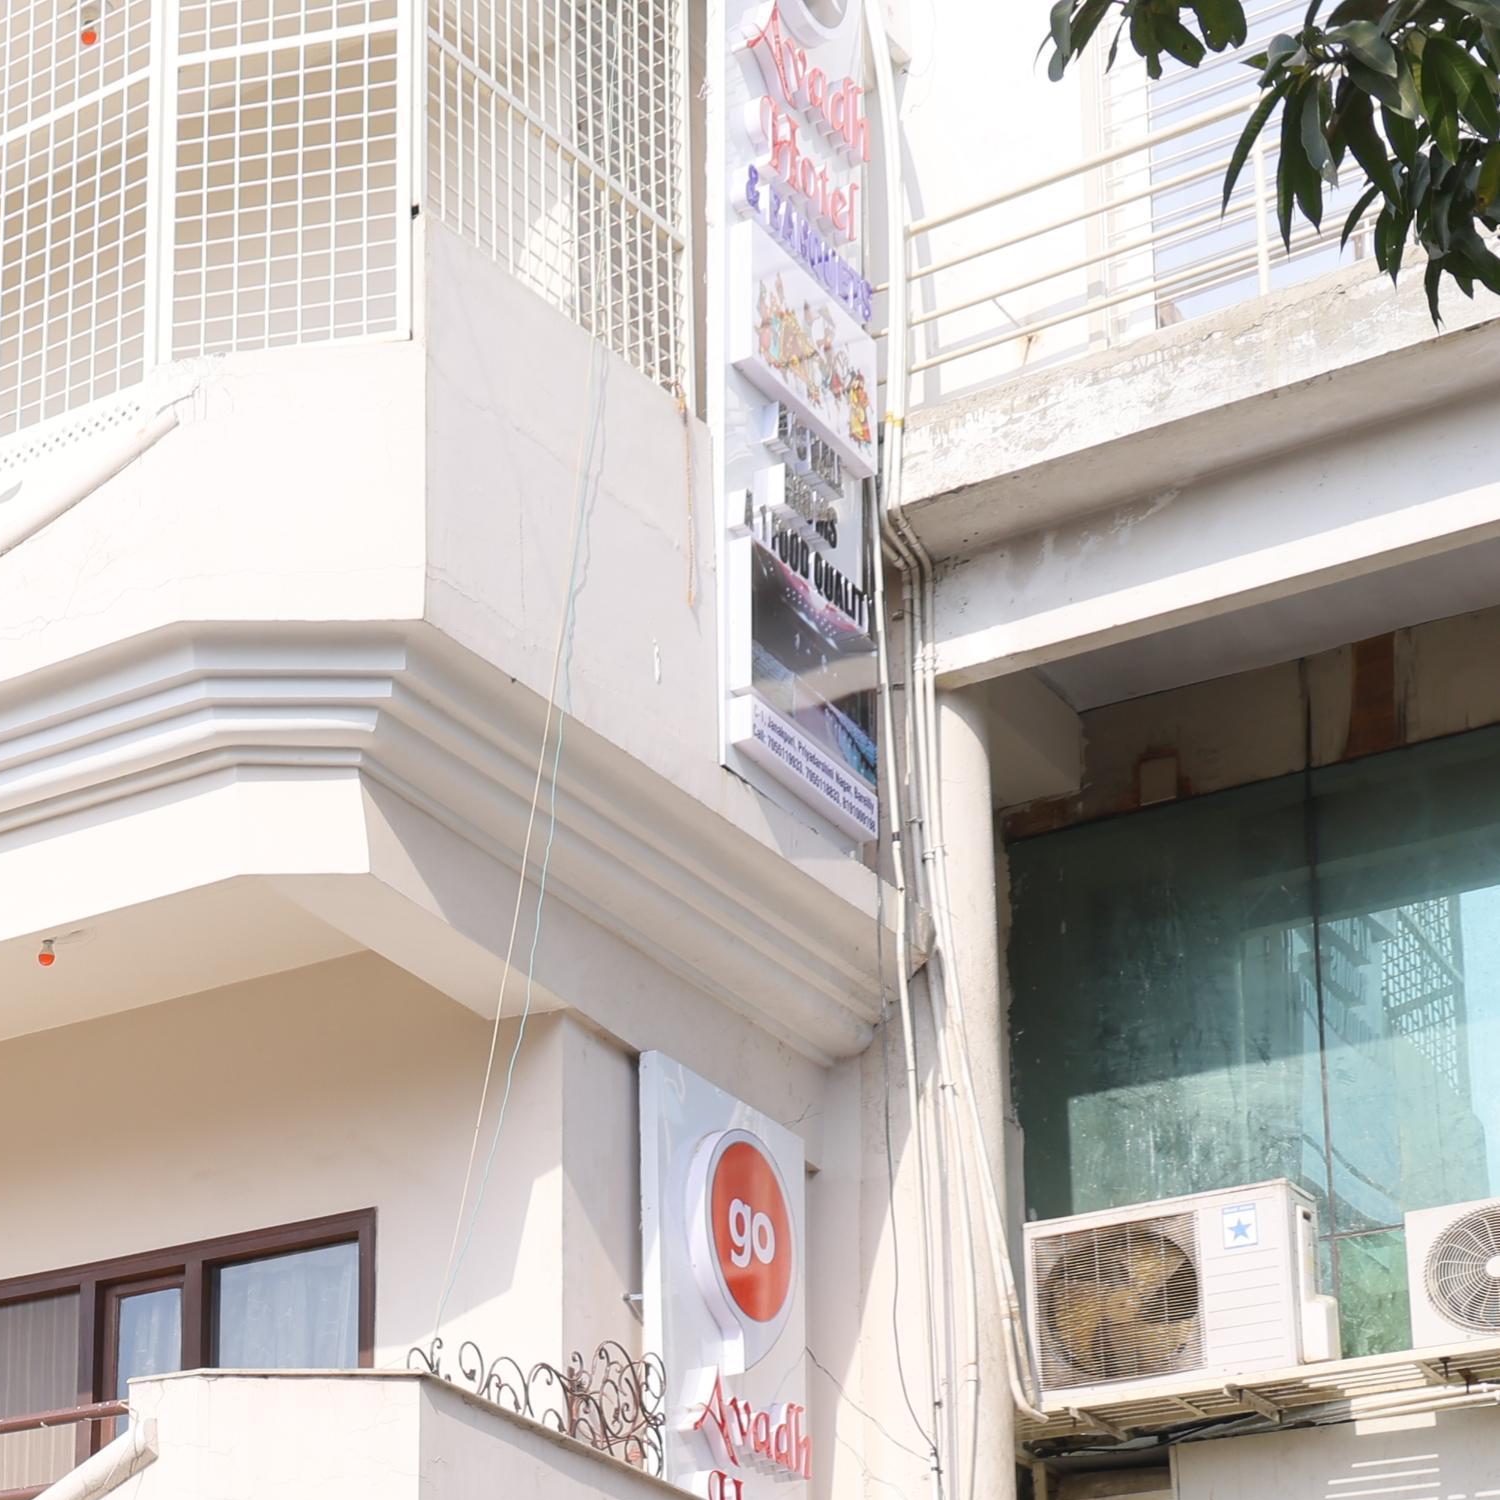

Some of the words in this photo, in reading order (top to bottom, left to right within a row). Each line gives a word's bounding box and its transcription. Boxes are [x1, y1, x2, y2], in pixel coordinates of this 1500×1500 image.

[747, 0, 870, 162] Avadh
[746, 163, 760, 214] &
[760, 95, 860, 241] Hotel
[729, 1198, 776, 1269] go
[694, 1366, 812, 1480] Avadh
